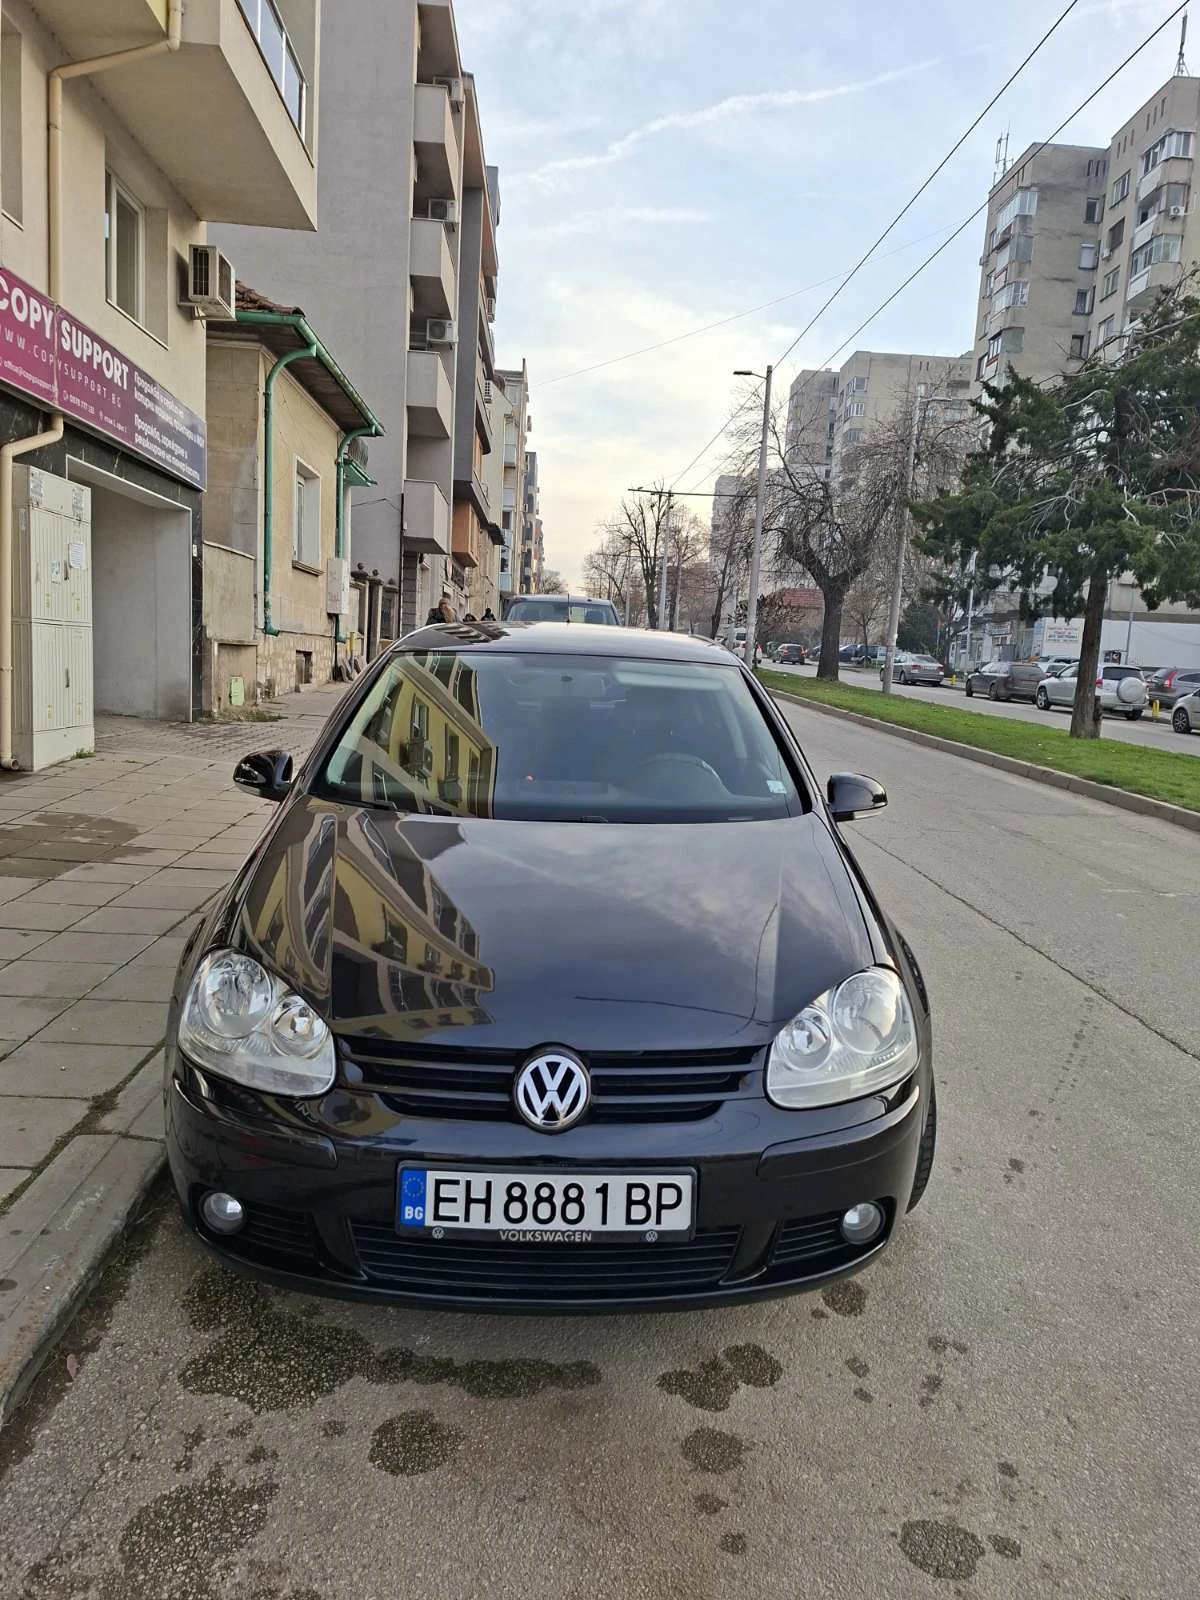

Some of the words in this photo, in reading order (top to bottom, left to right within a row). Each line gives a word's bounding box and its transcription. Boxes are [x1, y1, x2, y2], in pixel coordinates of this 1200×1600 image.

[61, 319, 129, 390] SUPPORT
[404, 1206, 424, 1220] BG
[432, 1178, 493, 1224] EH
[503, 1181, 609, 1226] 8881
[625, 1182, 683, 1226] BP
[499, 1229, 592, 1243] VOLKSWAGEN
